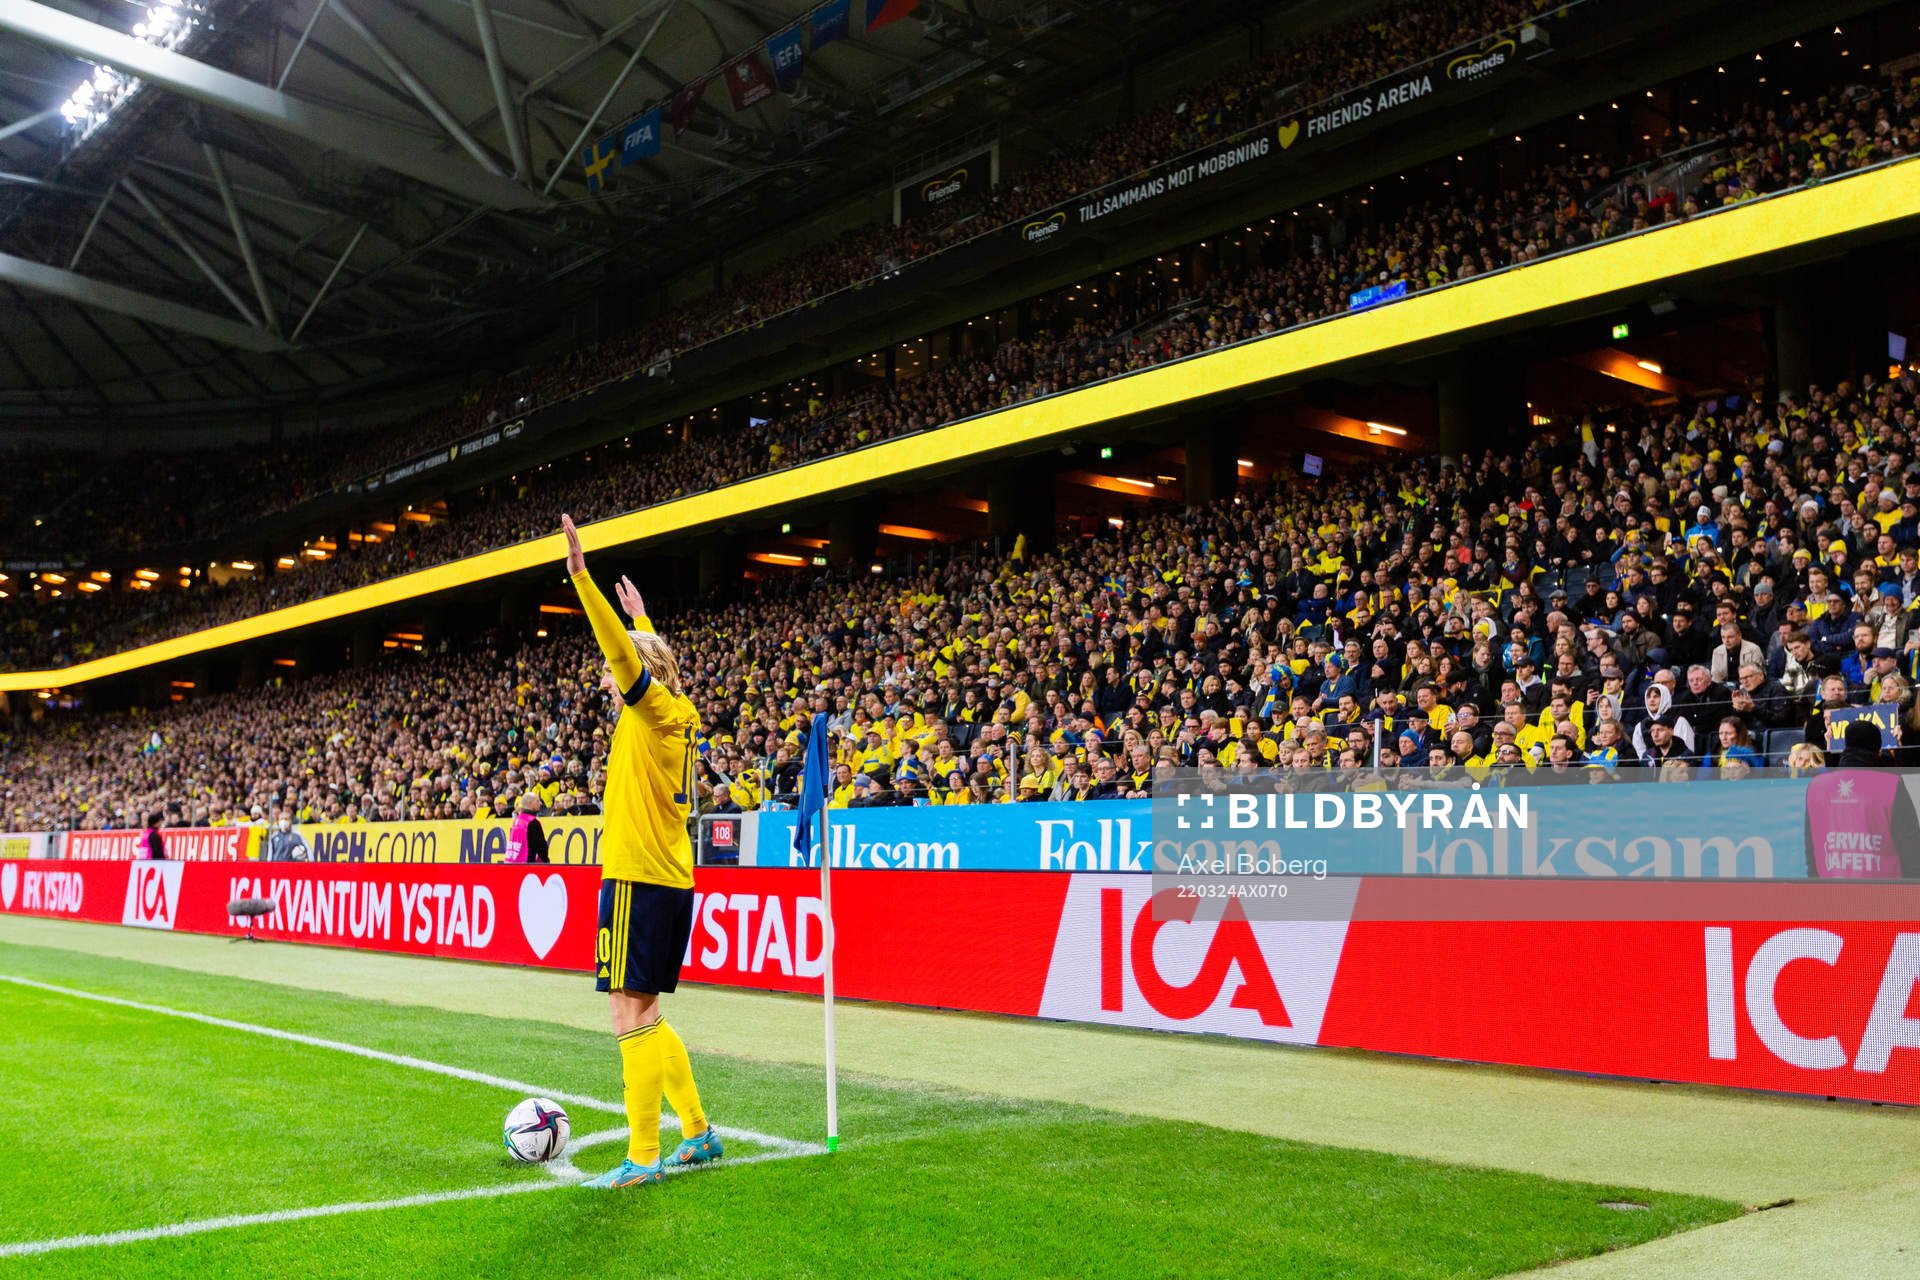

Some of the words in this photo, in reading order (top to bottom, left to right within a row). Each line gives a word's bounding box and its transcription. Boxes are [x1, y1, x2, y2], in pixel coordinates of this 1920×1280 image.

[1456, 53, 1505, 79] friends
[1308, 96, 1372, 138] FRIENDS
[1376, 75, 1432, 112] ARENA
[624, 125, 654, 152] FIFA
[928, 181, 961, 202] friends
[1079, 177, 1164, 223] TILLSAMMANS
[1168, 166, 1194, 190] MOT
[1198, 137, 1269, 179] MOBBNING
[1028, 221, 1060, 241] friends
[165, 834, 239, 861] AUHAUS
[715, 826, 730, 840] 108
[1035, 818, 1283, 872] Folksam
[1393, 810, 1775, 878] Folksam
[23, 871, 43, 910] IFK
[43, 871, 84, 912] YSTAD
[135, 866, 168, 923] ICA
[268, 878, 392, 940] KVANTUM
[399, 883, 496, 949] YSTAD
[1101, 887, 1293, 1028] ICA
